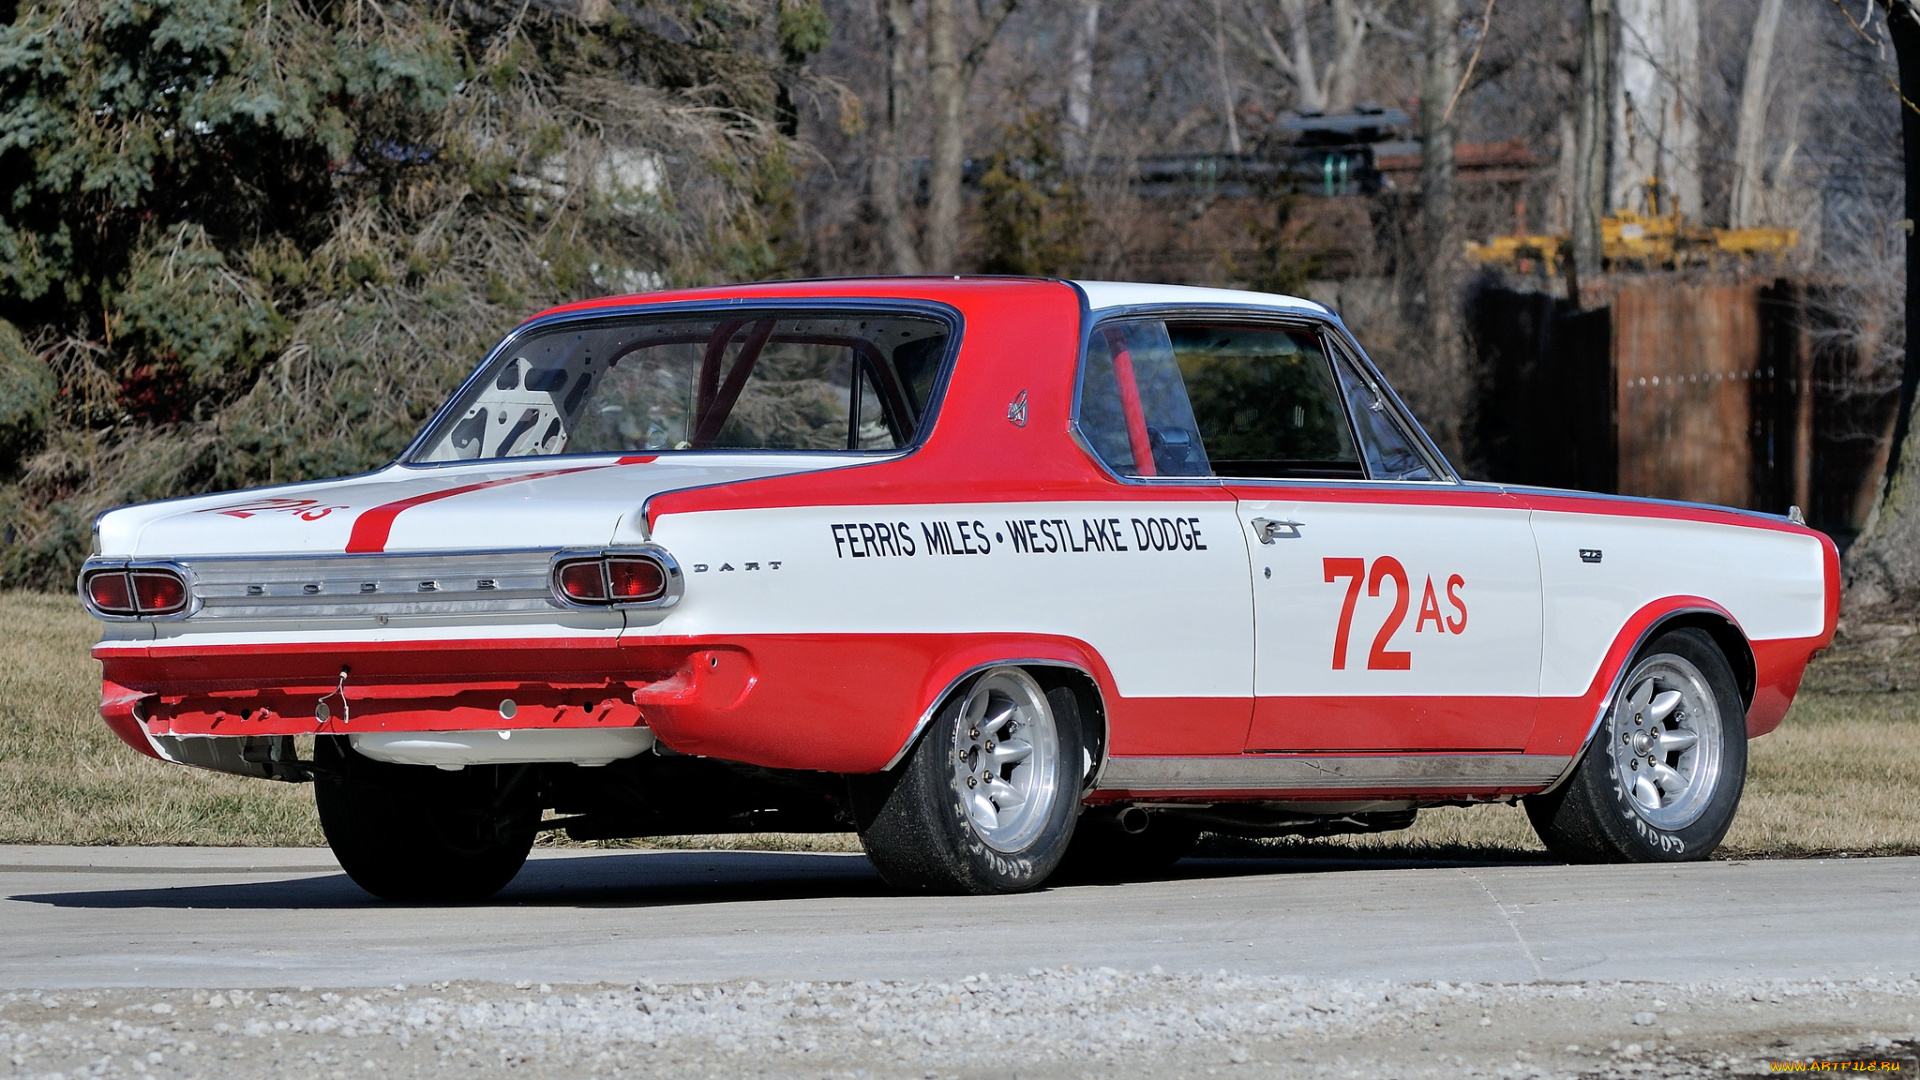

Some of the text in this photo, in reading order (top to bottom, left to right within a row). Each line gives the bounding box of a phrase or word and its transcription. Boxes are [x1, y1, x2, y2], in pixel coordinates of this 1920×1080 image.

[831, 517, 1207, 558] FERRIS MILES WESTLAKE DODGE
[693, 561, 782, 573] DART
[247, 578, 498, 595] DODGE
